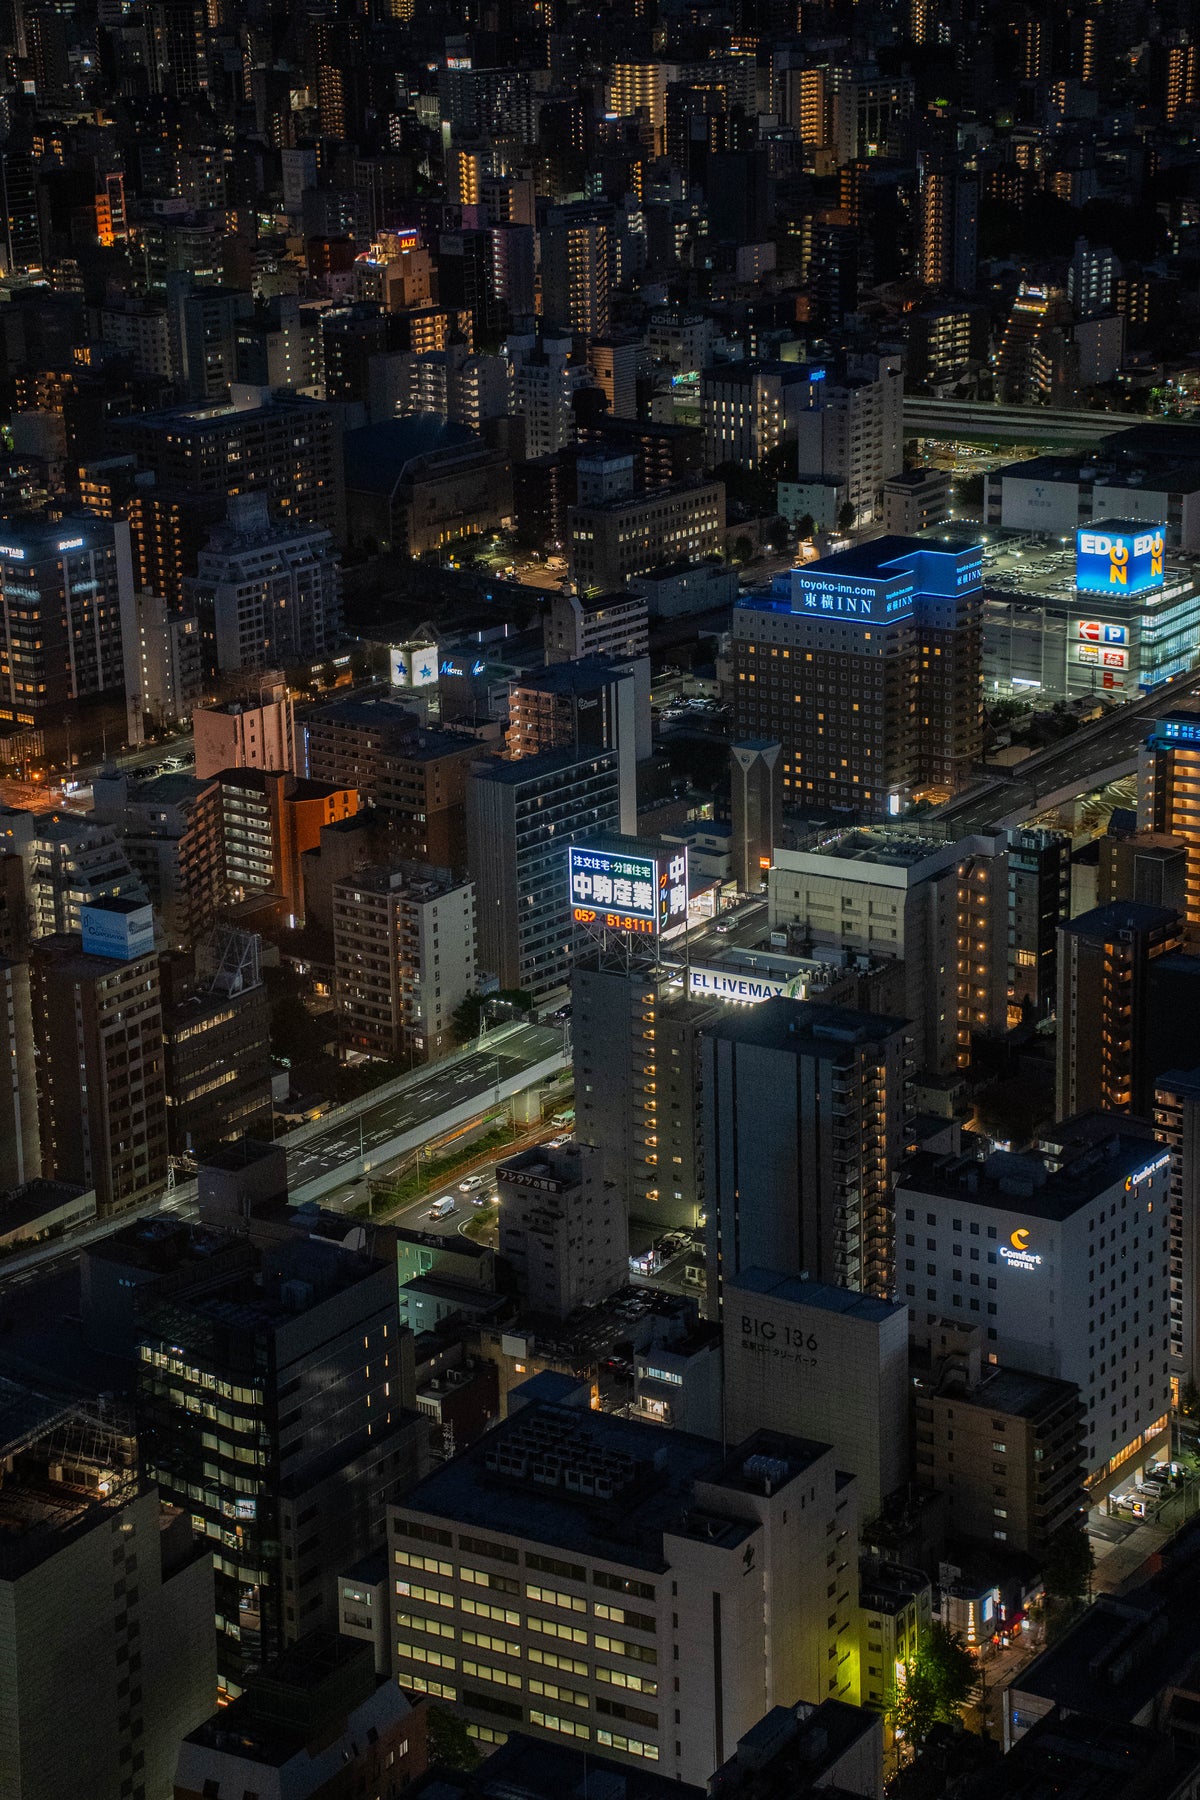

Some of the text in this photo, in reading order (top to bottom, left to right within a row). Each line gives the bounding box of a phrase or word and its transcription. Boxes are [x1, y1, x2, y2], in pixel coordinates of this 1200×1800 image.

[800, 579, 876, 597] toyoko-inn.com
[804, 592, 872, 614] 東横INN
[1109, 627, 1121, 640] P
[573, 855, 651, 878] 注文住宅・分譲住宅
[573, 872, 653, 911] 中駒産業
[669, 855, 686, 915] 中駒
[660, 873, 669, 928] グループ
[1000, 1246, 1042, 1265] Comfort
[1007, 1258, 1035, 1271] HOTEL
[742, 1315, 818, 1351] BIG 136
